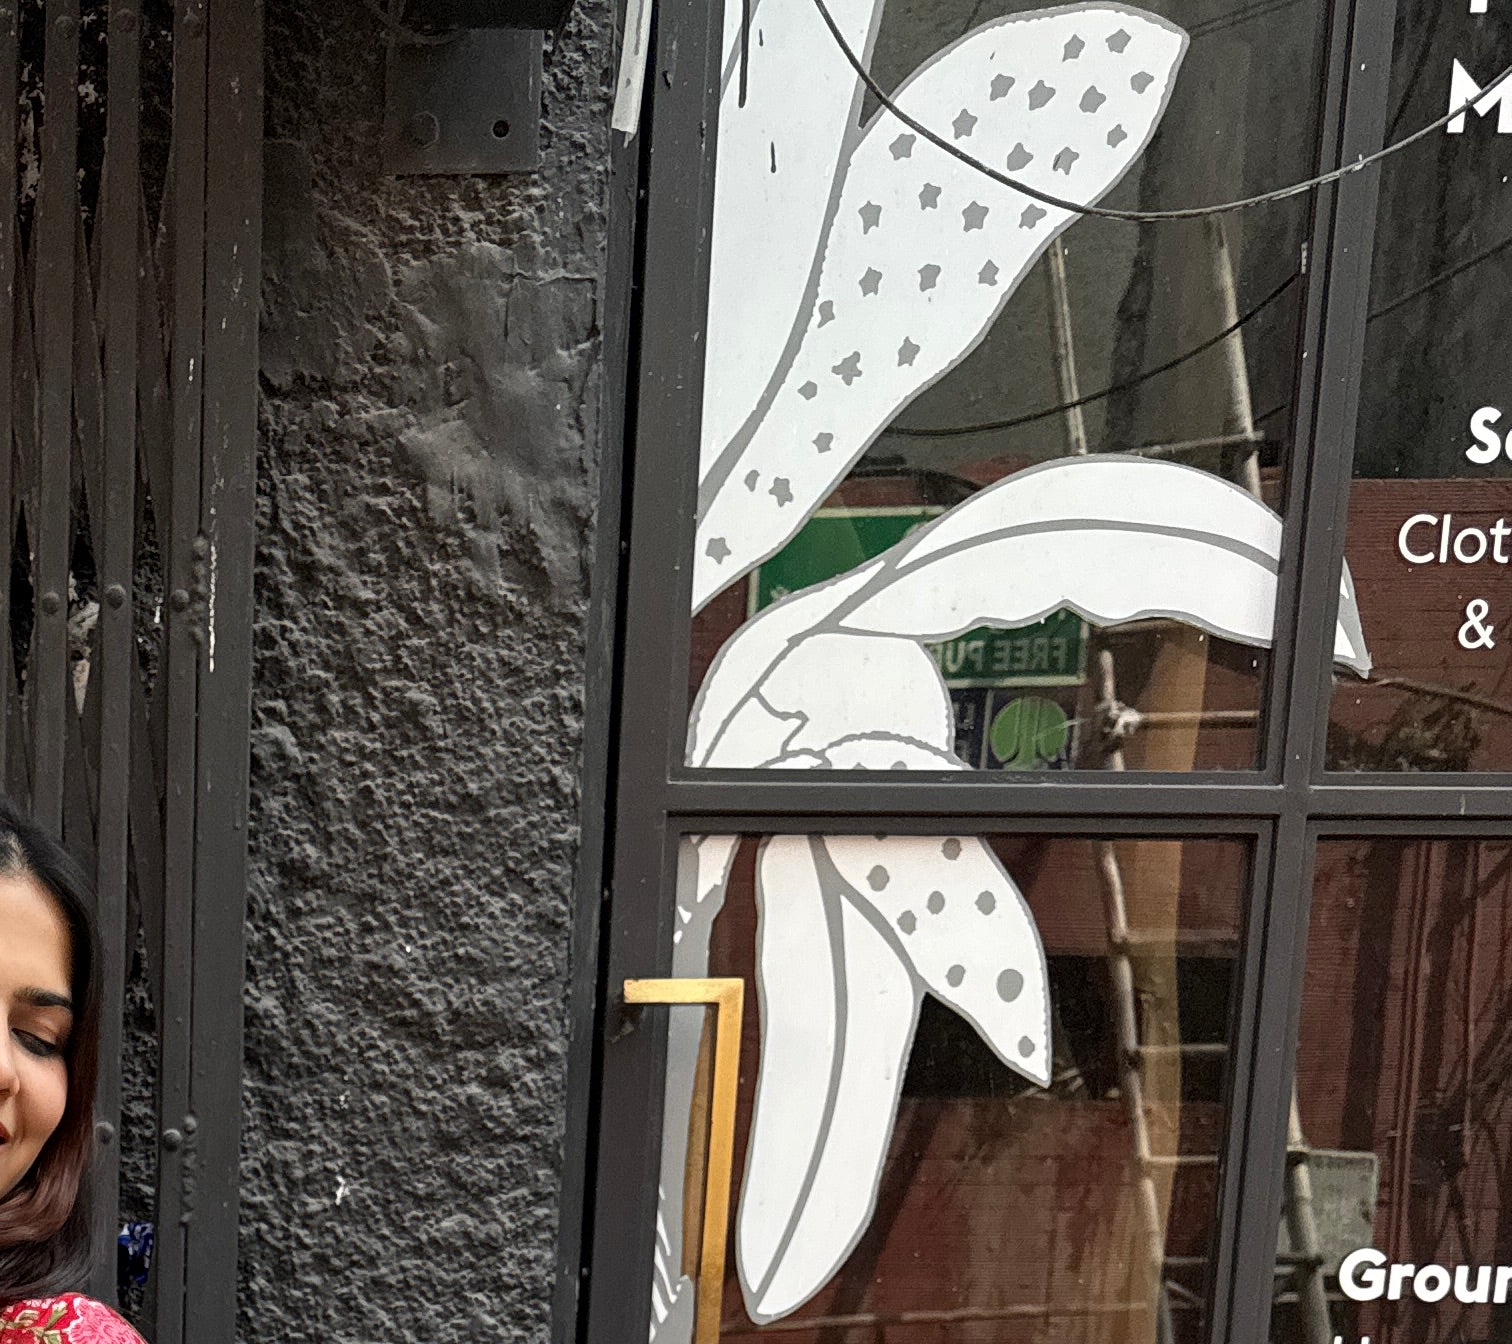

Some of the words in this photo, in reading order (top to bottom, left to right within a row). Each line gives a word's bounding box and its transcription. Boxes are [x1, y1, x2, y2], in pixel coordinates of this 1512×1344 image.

[1464, 406, 1512, 465] S
[1398, 513, 1512, 564] Clot
[1457, 598, 1496, 650] &
